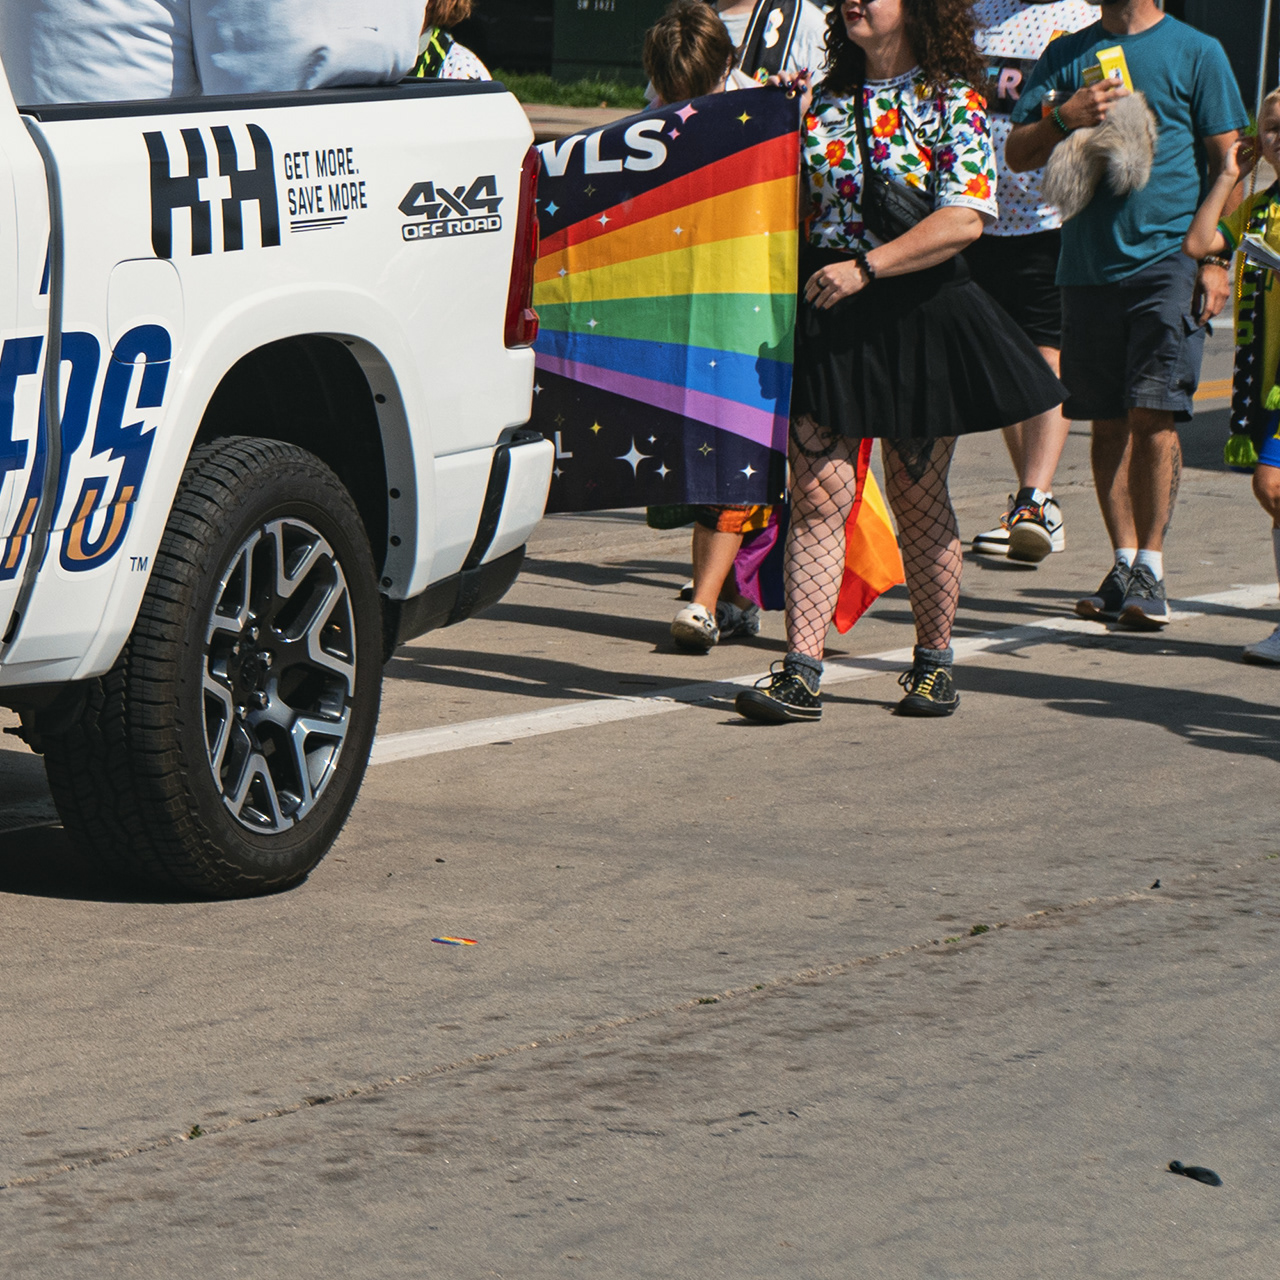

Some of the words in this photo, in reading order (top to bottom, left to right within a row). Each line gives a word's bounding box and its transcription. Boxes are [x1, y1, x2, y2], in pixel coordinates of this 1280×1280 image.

[284, 151, 310, 181] GET
[316, 147, 360, 179] MORE.
[288, 185, 325, 216] SAVE
[329, 180, 368, 212] MORE
[402, 220, 444, 240] OFF
[447, 216, 502, 235] ROAD
[129, 556, 149, 572] TM
